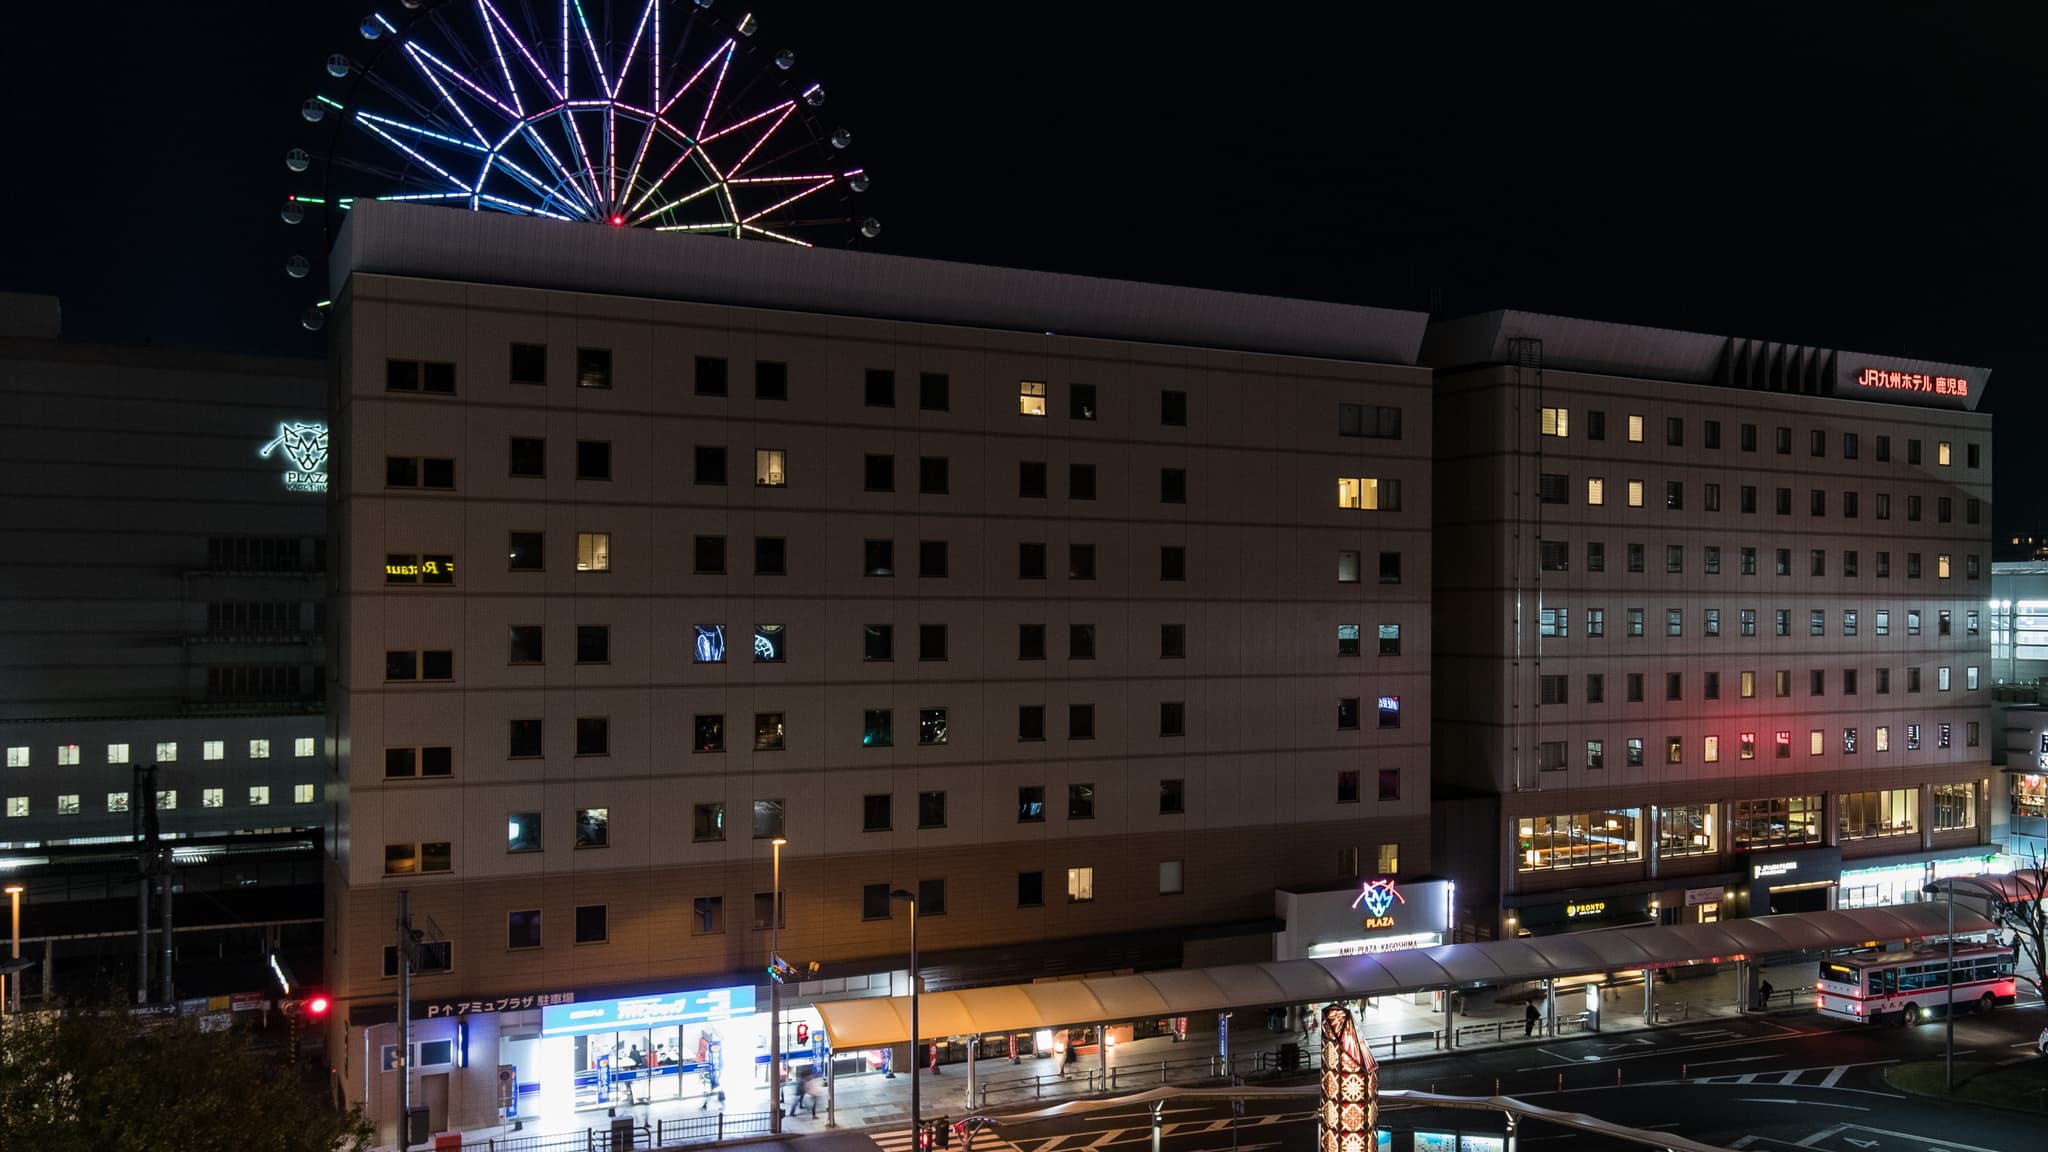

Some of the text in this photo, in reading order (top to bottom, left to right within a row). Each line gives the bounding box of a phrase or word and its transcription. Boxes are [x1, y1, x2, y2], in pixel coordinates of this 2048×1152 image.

[1858, 369, 1968, 396] JR九州ホテル 鹿児島
[1576, 902, 1605, 913] PRONTO
[1366, 917, 1394, 928] PLAZA
[1339, 940, 1417, 956] AMU PLAZA KAGOSHIMA
[427, 992, 575, 1018] P アミュプラザ 駐車場
[1843, 1137, 1880, 1149] 4
